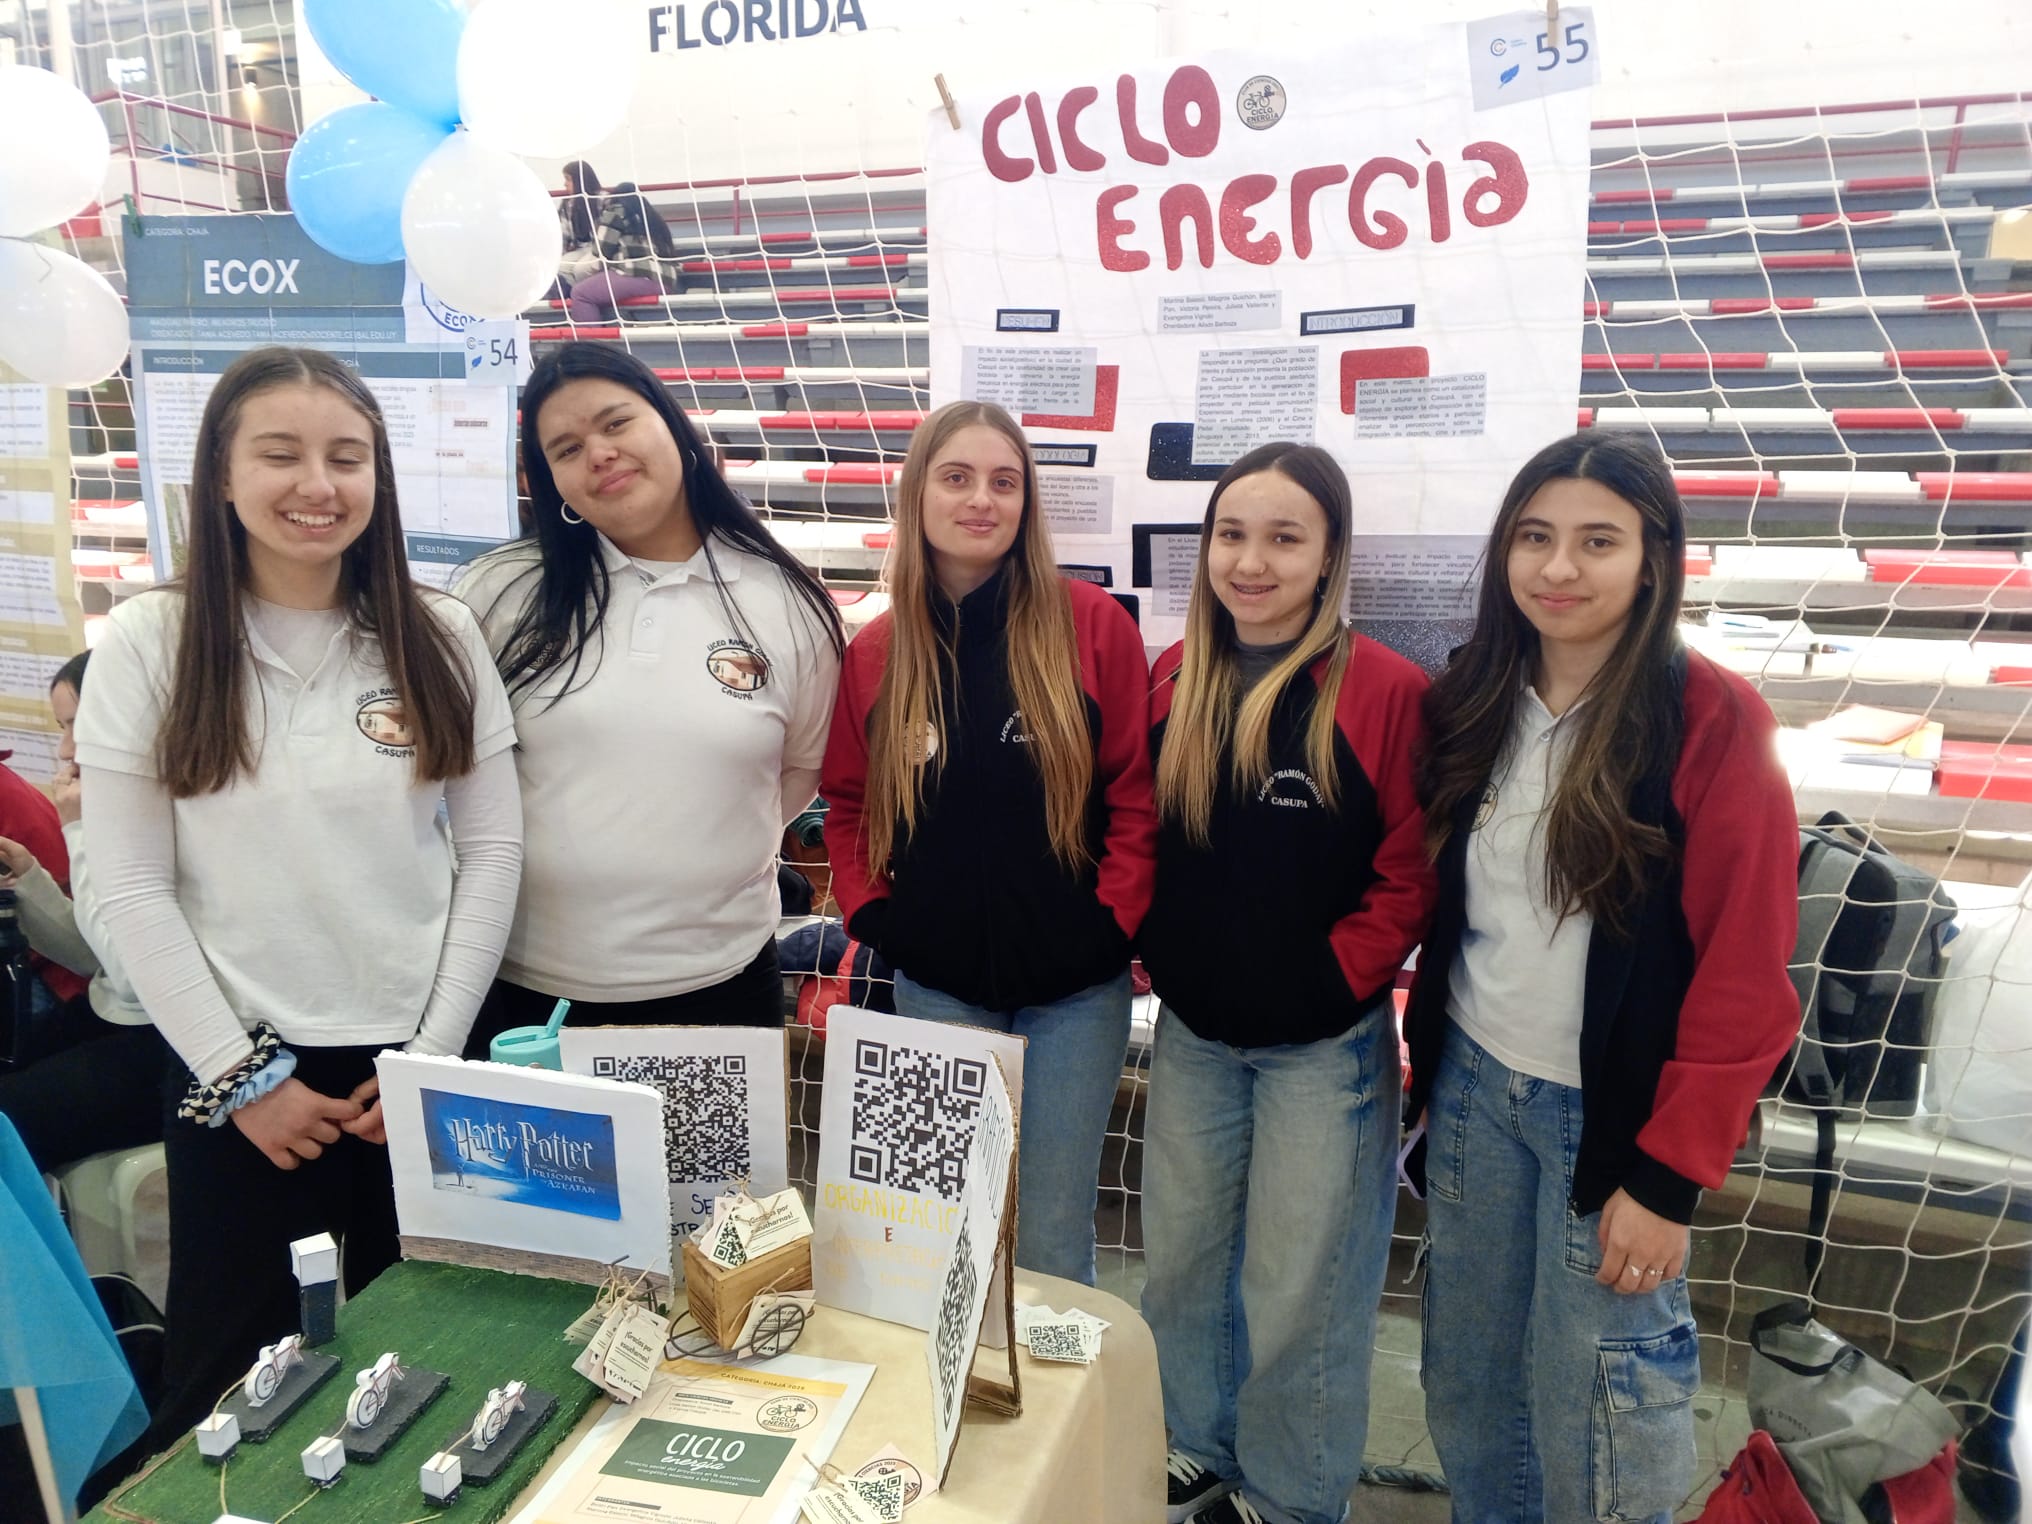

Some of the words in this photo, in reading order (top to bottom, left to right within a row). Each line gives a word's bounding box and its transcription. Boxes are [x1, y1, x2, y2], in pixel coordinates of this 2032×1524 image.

[649, 0, 868, 53] FLORIDA
[1536, 22, 1589, 72] 55
[982, 64, 1221, 183] CICLO
[204, 259, 300, 295] ECOX
[490, 338, 519, 367] 54
[416, 544, 460, 557] RESULTADOS
[449, 1116, 518, 1164] Harry
[516, 1120, 594, 1184] Potter
[532, 1168, 586, 1185] PRISONER
[776, 1204, 789, 1216] por
[885, 1227, 894, 1243] E
[665, 1432, 746, 1462] CICLO
